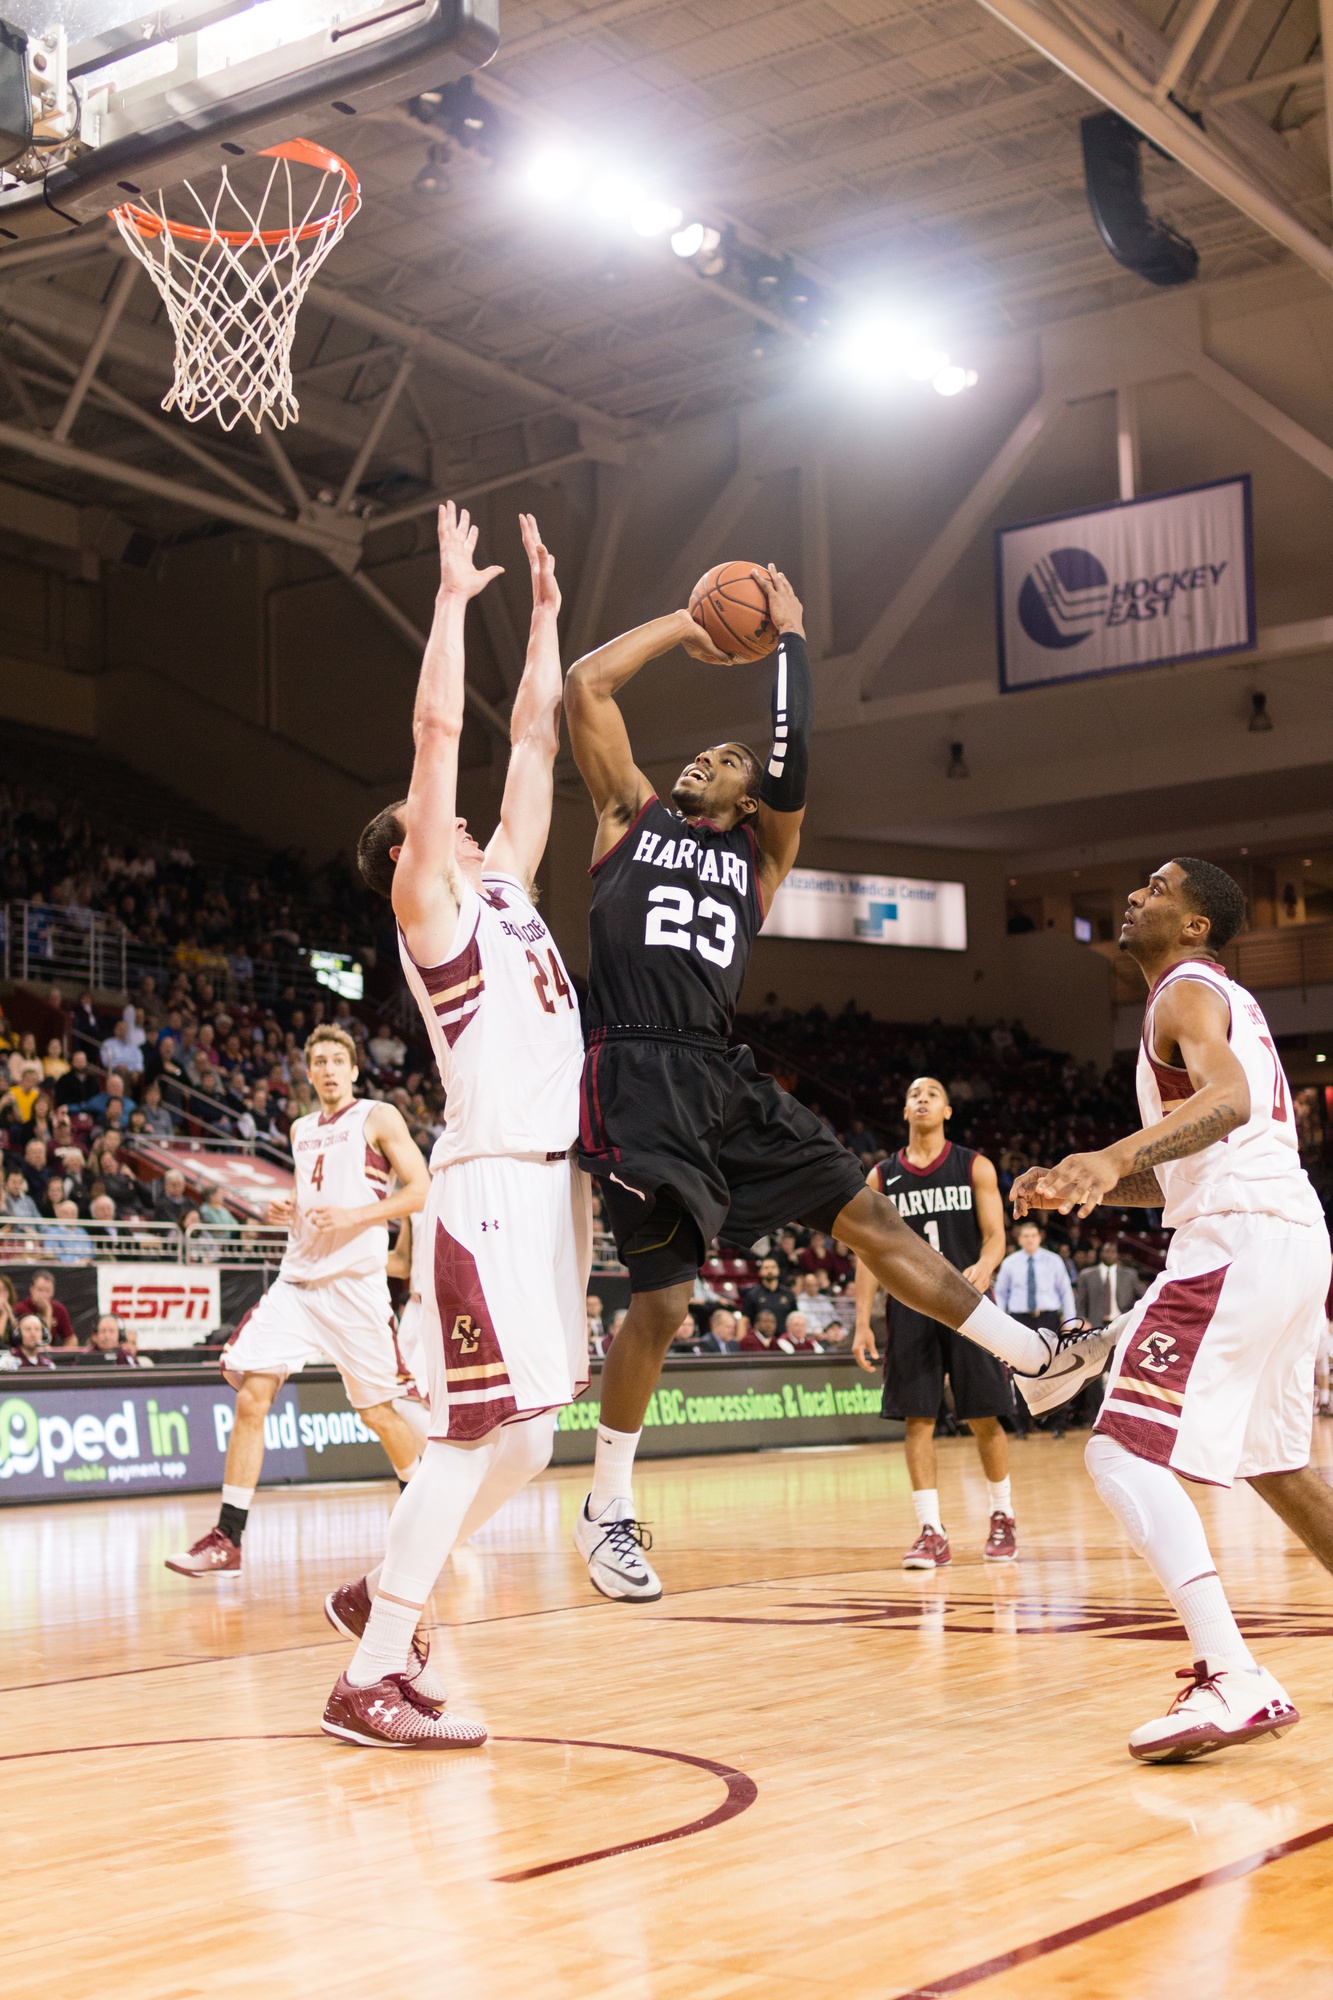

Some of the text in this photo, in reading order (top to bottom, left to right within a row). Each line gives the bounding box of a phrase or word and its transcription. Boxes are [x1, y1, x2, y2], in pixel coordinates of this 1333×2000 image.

[1112, 560, 1228, 603] HOCKEY
[1105, 597, 1170, 627] EAST
[848, 879, 897, 898] Medical
[899, 884, 938, 902] Center
[644, 884, 737, 970] 23
[524, 947, 575, 1014] 24
[310, 1153, 325, 1192] 4
[923, 1219, 944, 1256] 1
[110, 1285, 211, 1320] ESPN
[146, 1397, 191, 1457] in
[213, 1400, 299, 1453] Pud
[558, 1400, 601, 1432] acce
[658, 1387, 687, 1426] BC
[685, 1386, 785, 1425] concessions
[781, 1383, 800, 1419] &
[796, 1381, 836, 1418] local
[834, 1381, 884, 1416] restau
[107, 1460, 162, 1484] payment
[161, 1460, 187, 1480] app
